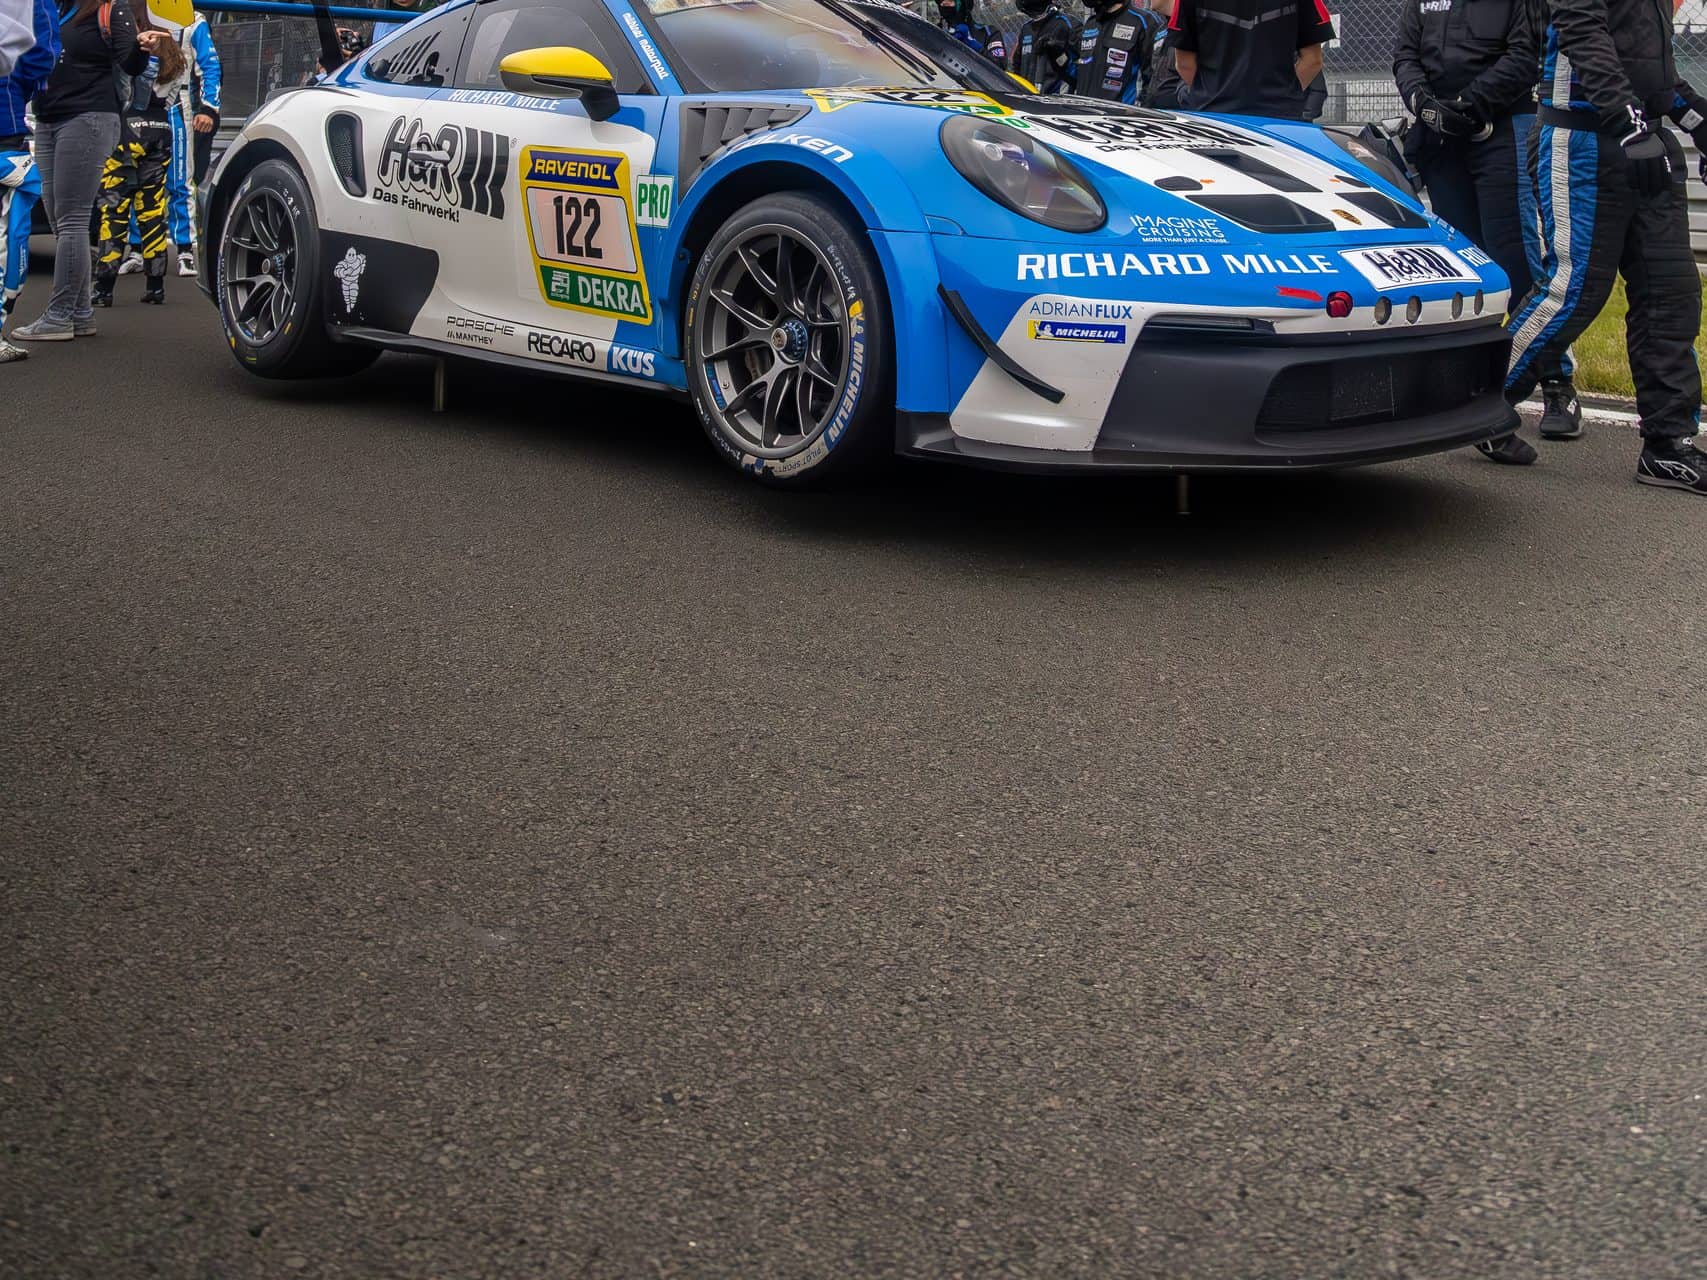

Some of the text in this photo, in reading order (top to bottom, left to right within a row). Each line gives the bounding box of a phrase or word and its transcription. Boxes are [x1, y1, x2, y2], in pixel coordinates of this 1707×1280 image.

[448, 89, 561, 110] RICHARD MILLE
[534, 158, 612, 181] RAVENOL
[373, 187, 460, 223] Das Fahrwerk!
[637, 182, 671, 220] PRO
[553, 194, 603, 260] 122
[1129, 214, 1218, 230] IMAGINE
[1137, 227, 1225, 239] CRUISING
[1017, 252, 1339, 281] RICHARD MILLE
[1362, 248, 1445, 282] H&R
[577, 275, 645, 315] DEKRA
[447, 316, 515, 337] PORSCHE
[455, 332, 494, 346] MANTHEY
[1055, 327, 1118, 340] MICHELIN
[527, 331, 596, 364] RECARO
[611, 345, 655, 377] KÜS
[829, 340, 864, 443] MICHELIN
